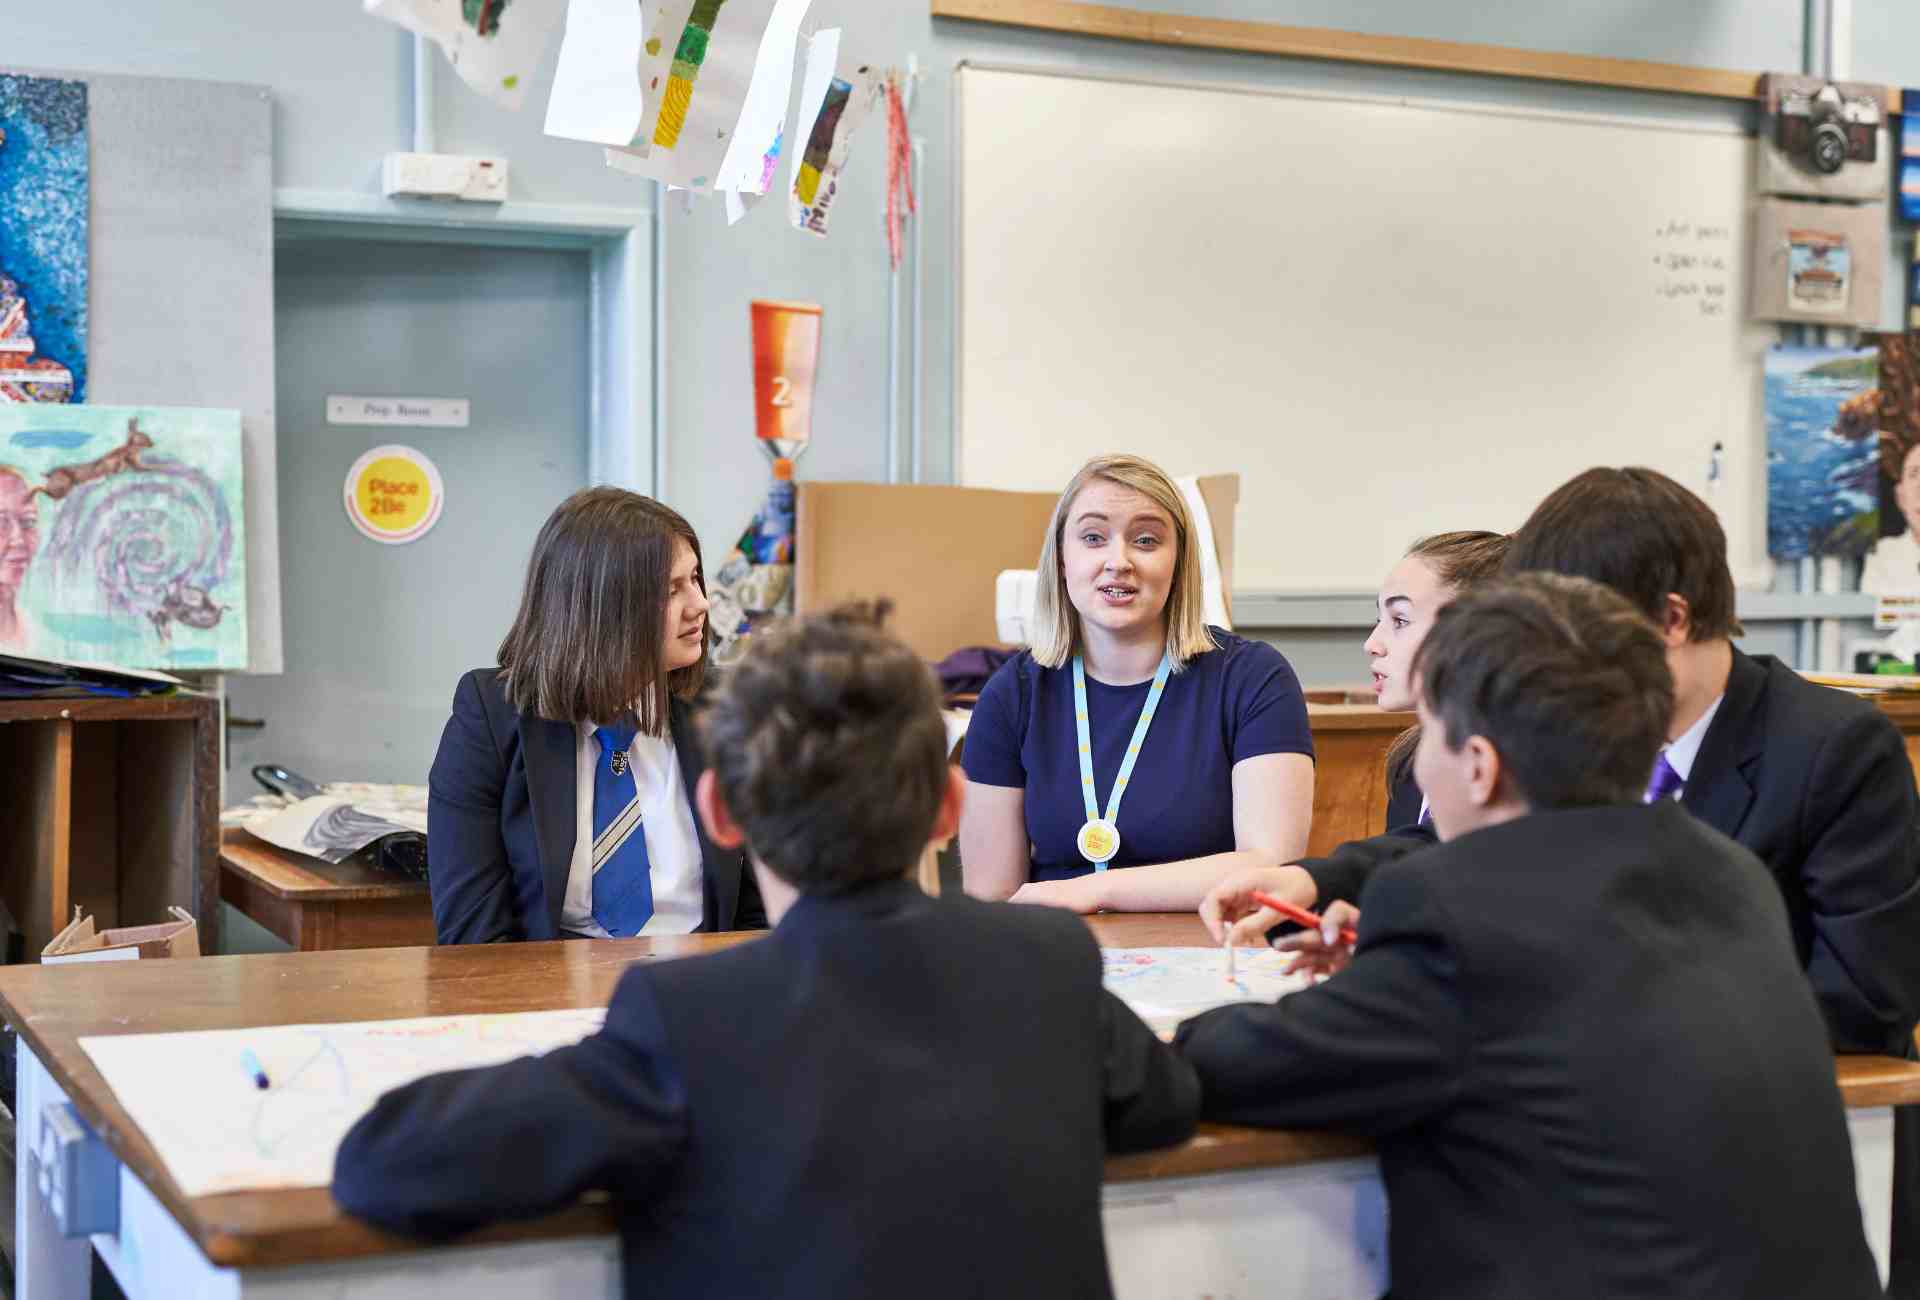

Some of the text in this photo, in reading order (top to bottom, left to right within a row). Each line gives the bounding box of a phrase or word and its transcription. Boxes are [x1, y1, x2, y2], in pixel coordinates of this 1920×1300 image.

[772, 376, 793, 407] 2
[368, 478, 419, 497] Place
[369, 496, 406, 515] 2Be
